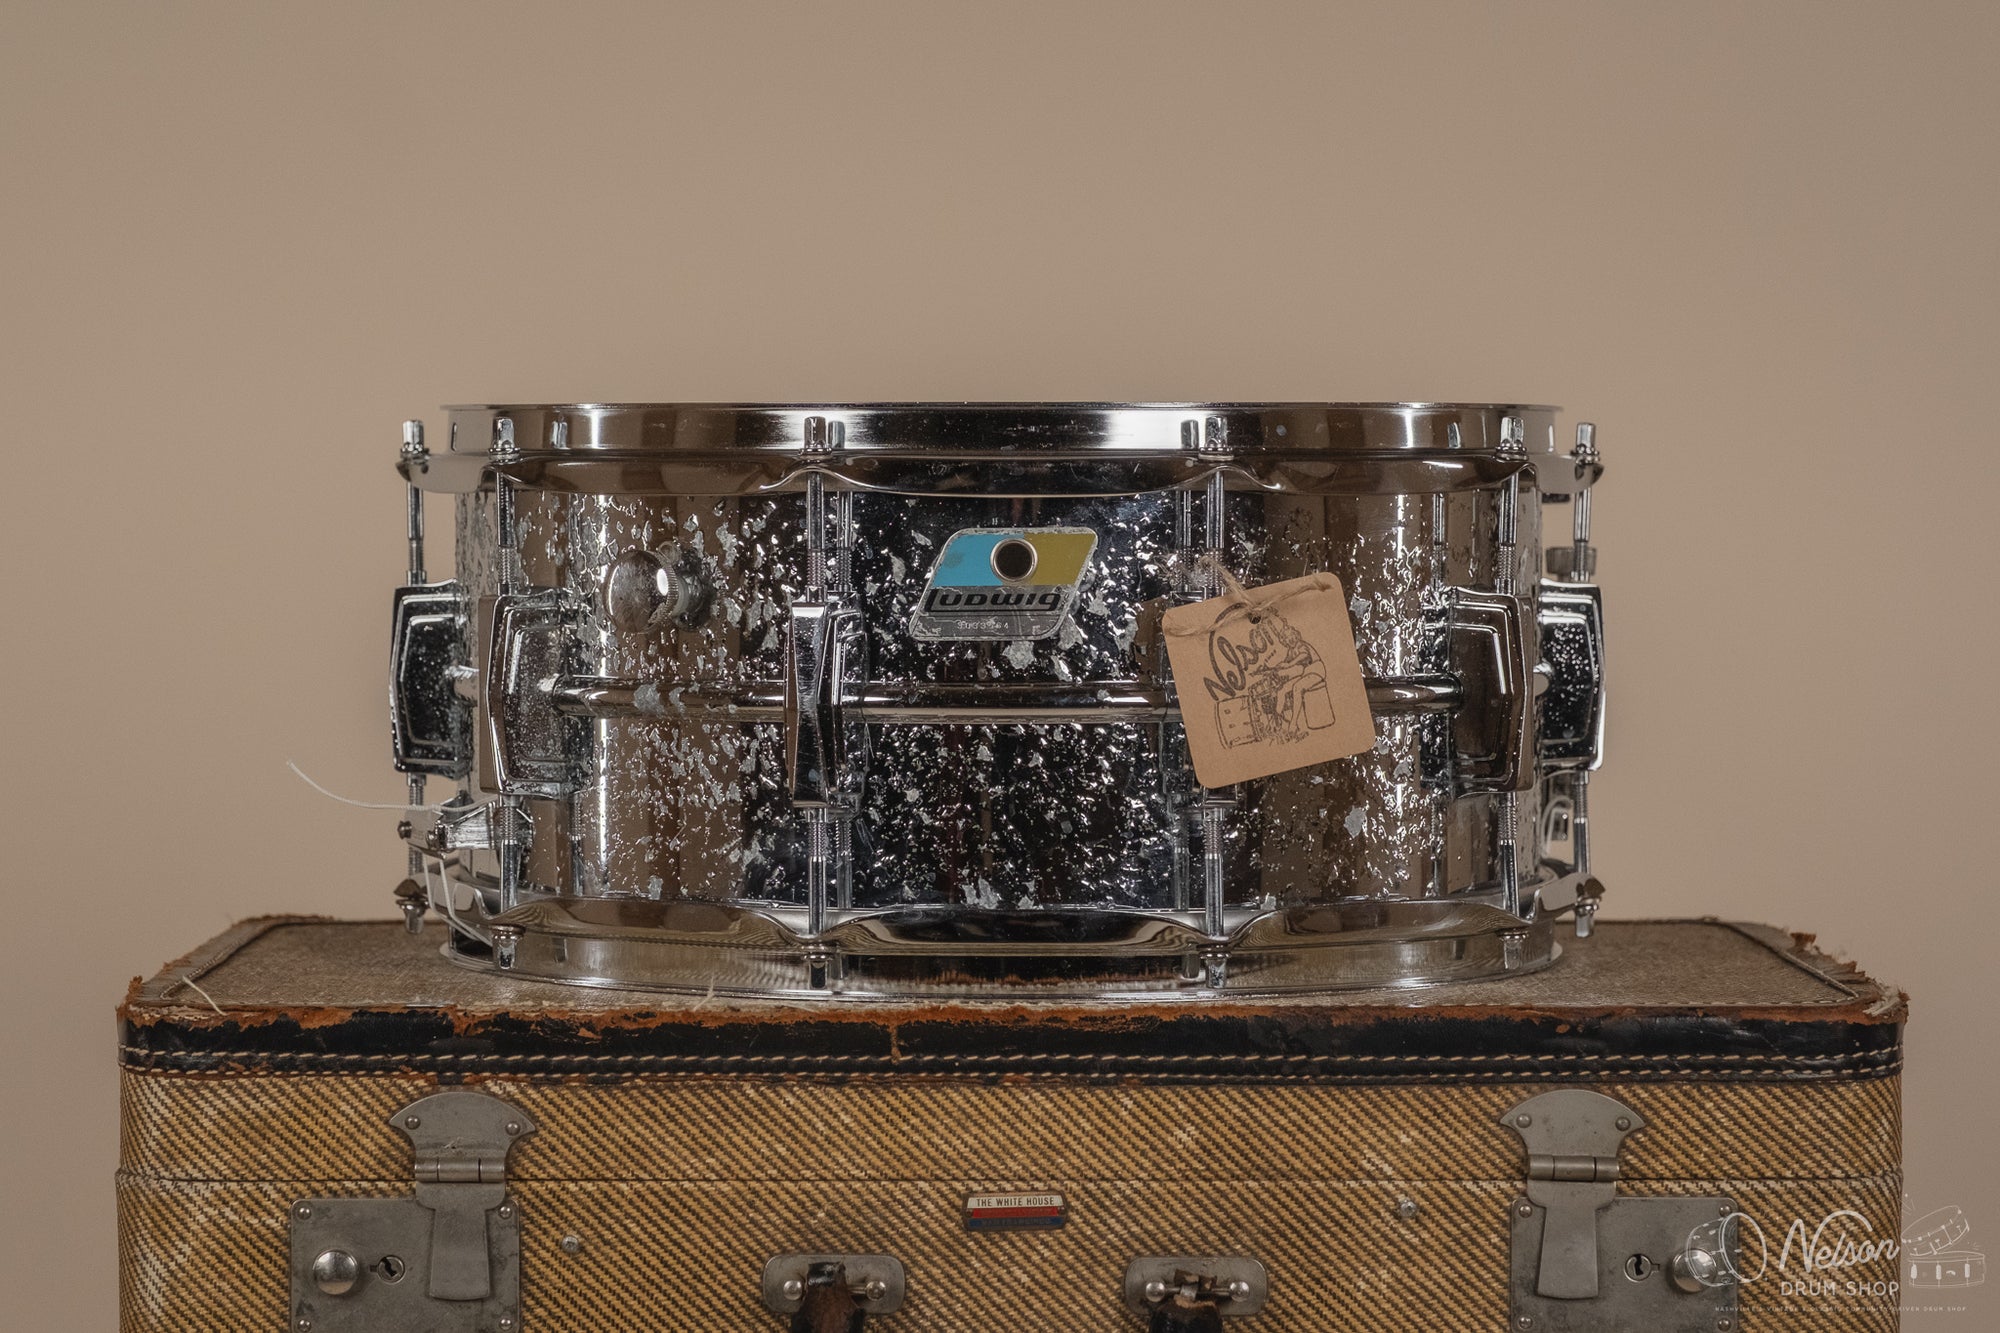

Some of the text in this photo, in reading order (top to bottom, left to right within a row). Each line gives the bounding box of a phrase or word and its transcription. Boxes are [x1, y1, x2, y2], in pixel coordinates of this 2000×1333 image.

[976, 1197, 1054, 1207] THE WHITE HOUSE
